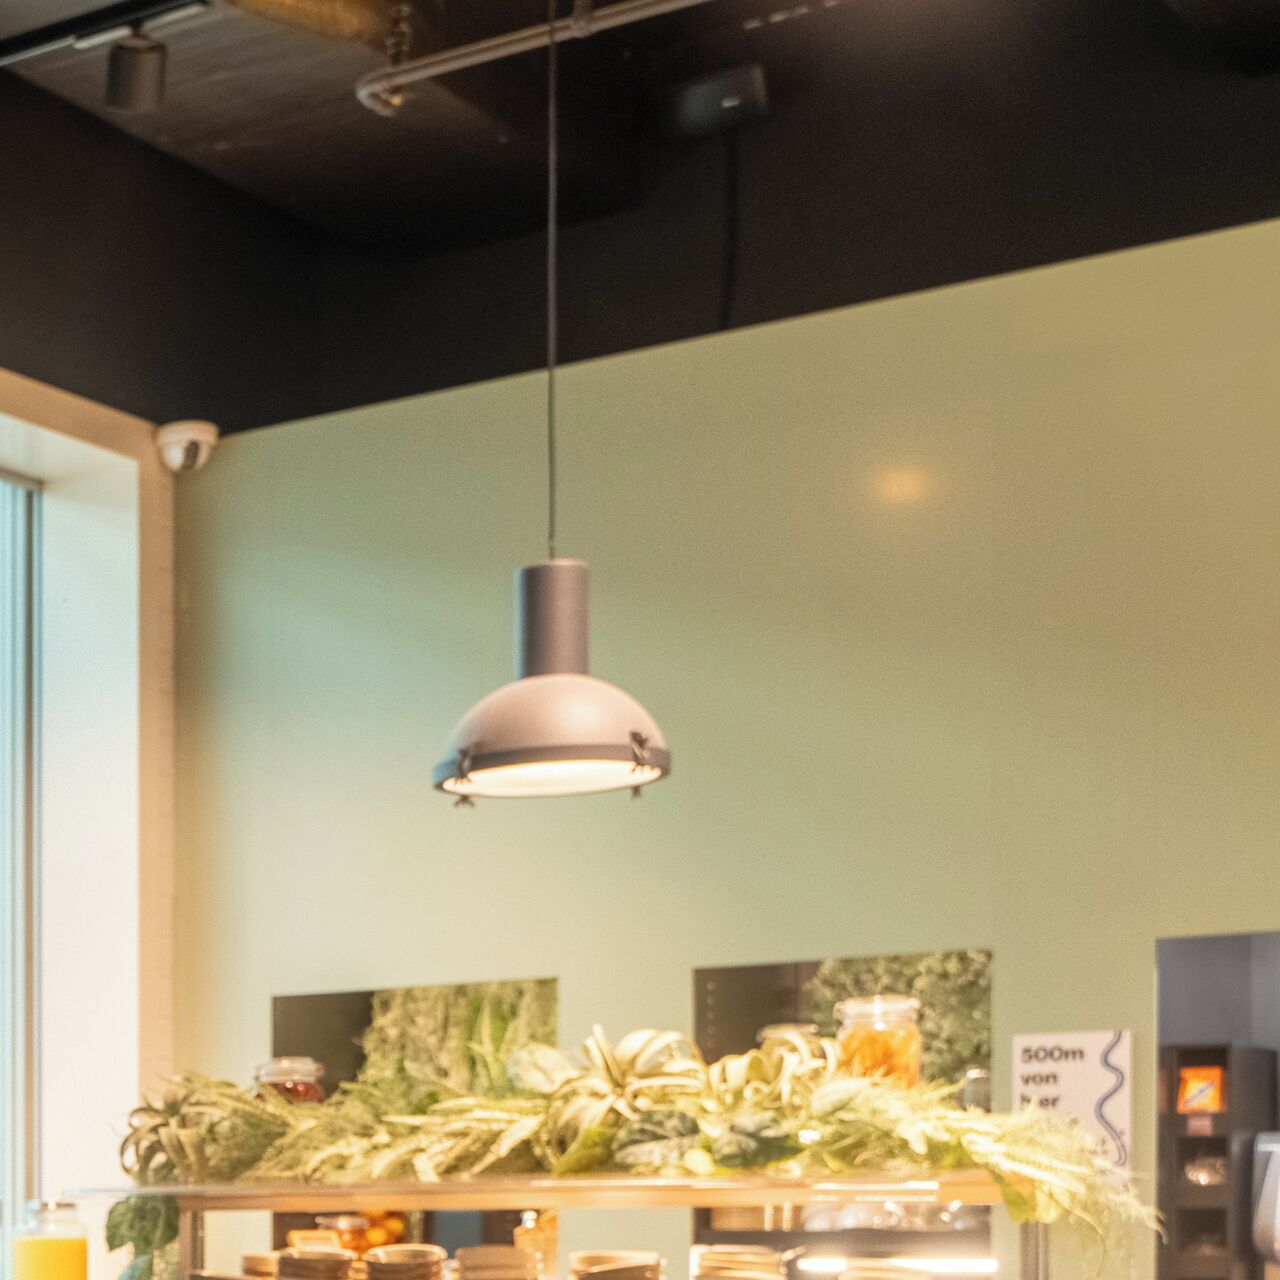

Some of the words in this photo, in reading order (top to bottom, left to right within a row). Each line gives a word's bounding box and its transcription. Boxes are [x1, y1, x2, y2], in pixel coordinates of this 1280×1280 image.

[1022, 1045, 1084, 1063] 500m
[1021, 1074, 1058, 1086] von
[1021, 1093, 1060, 1108] her
